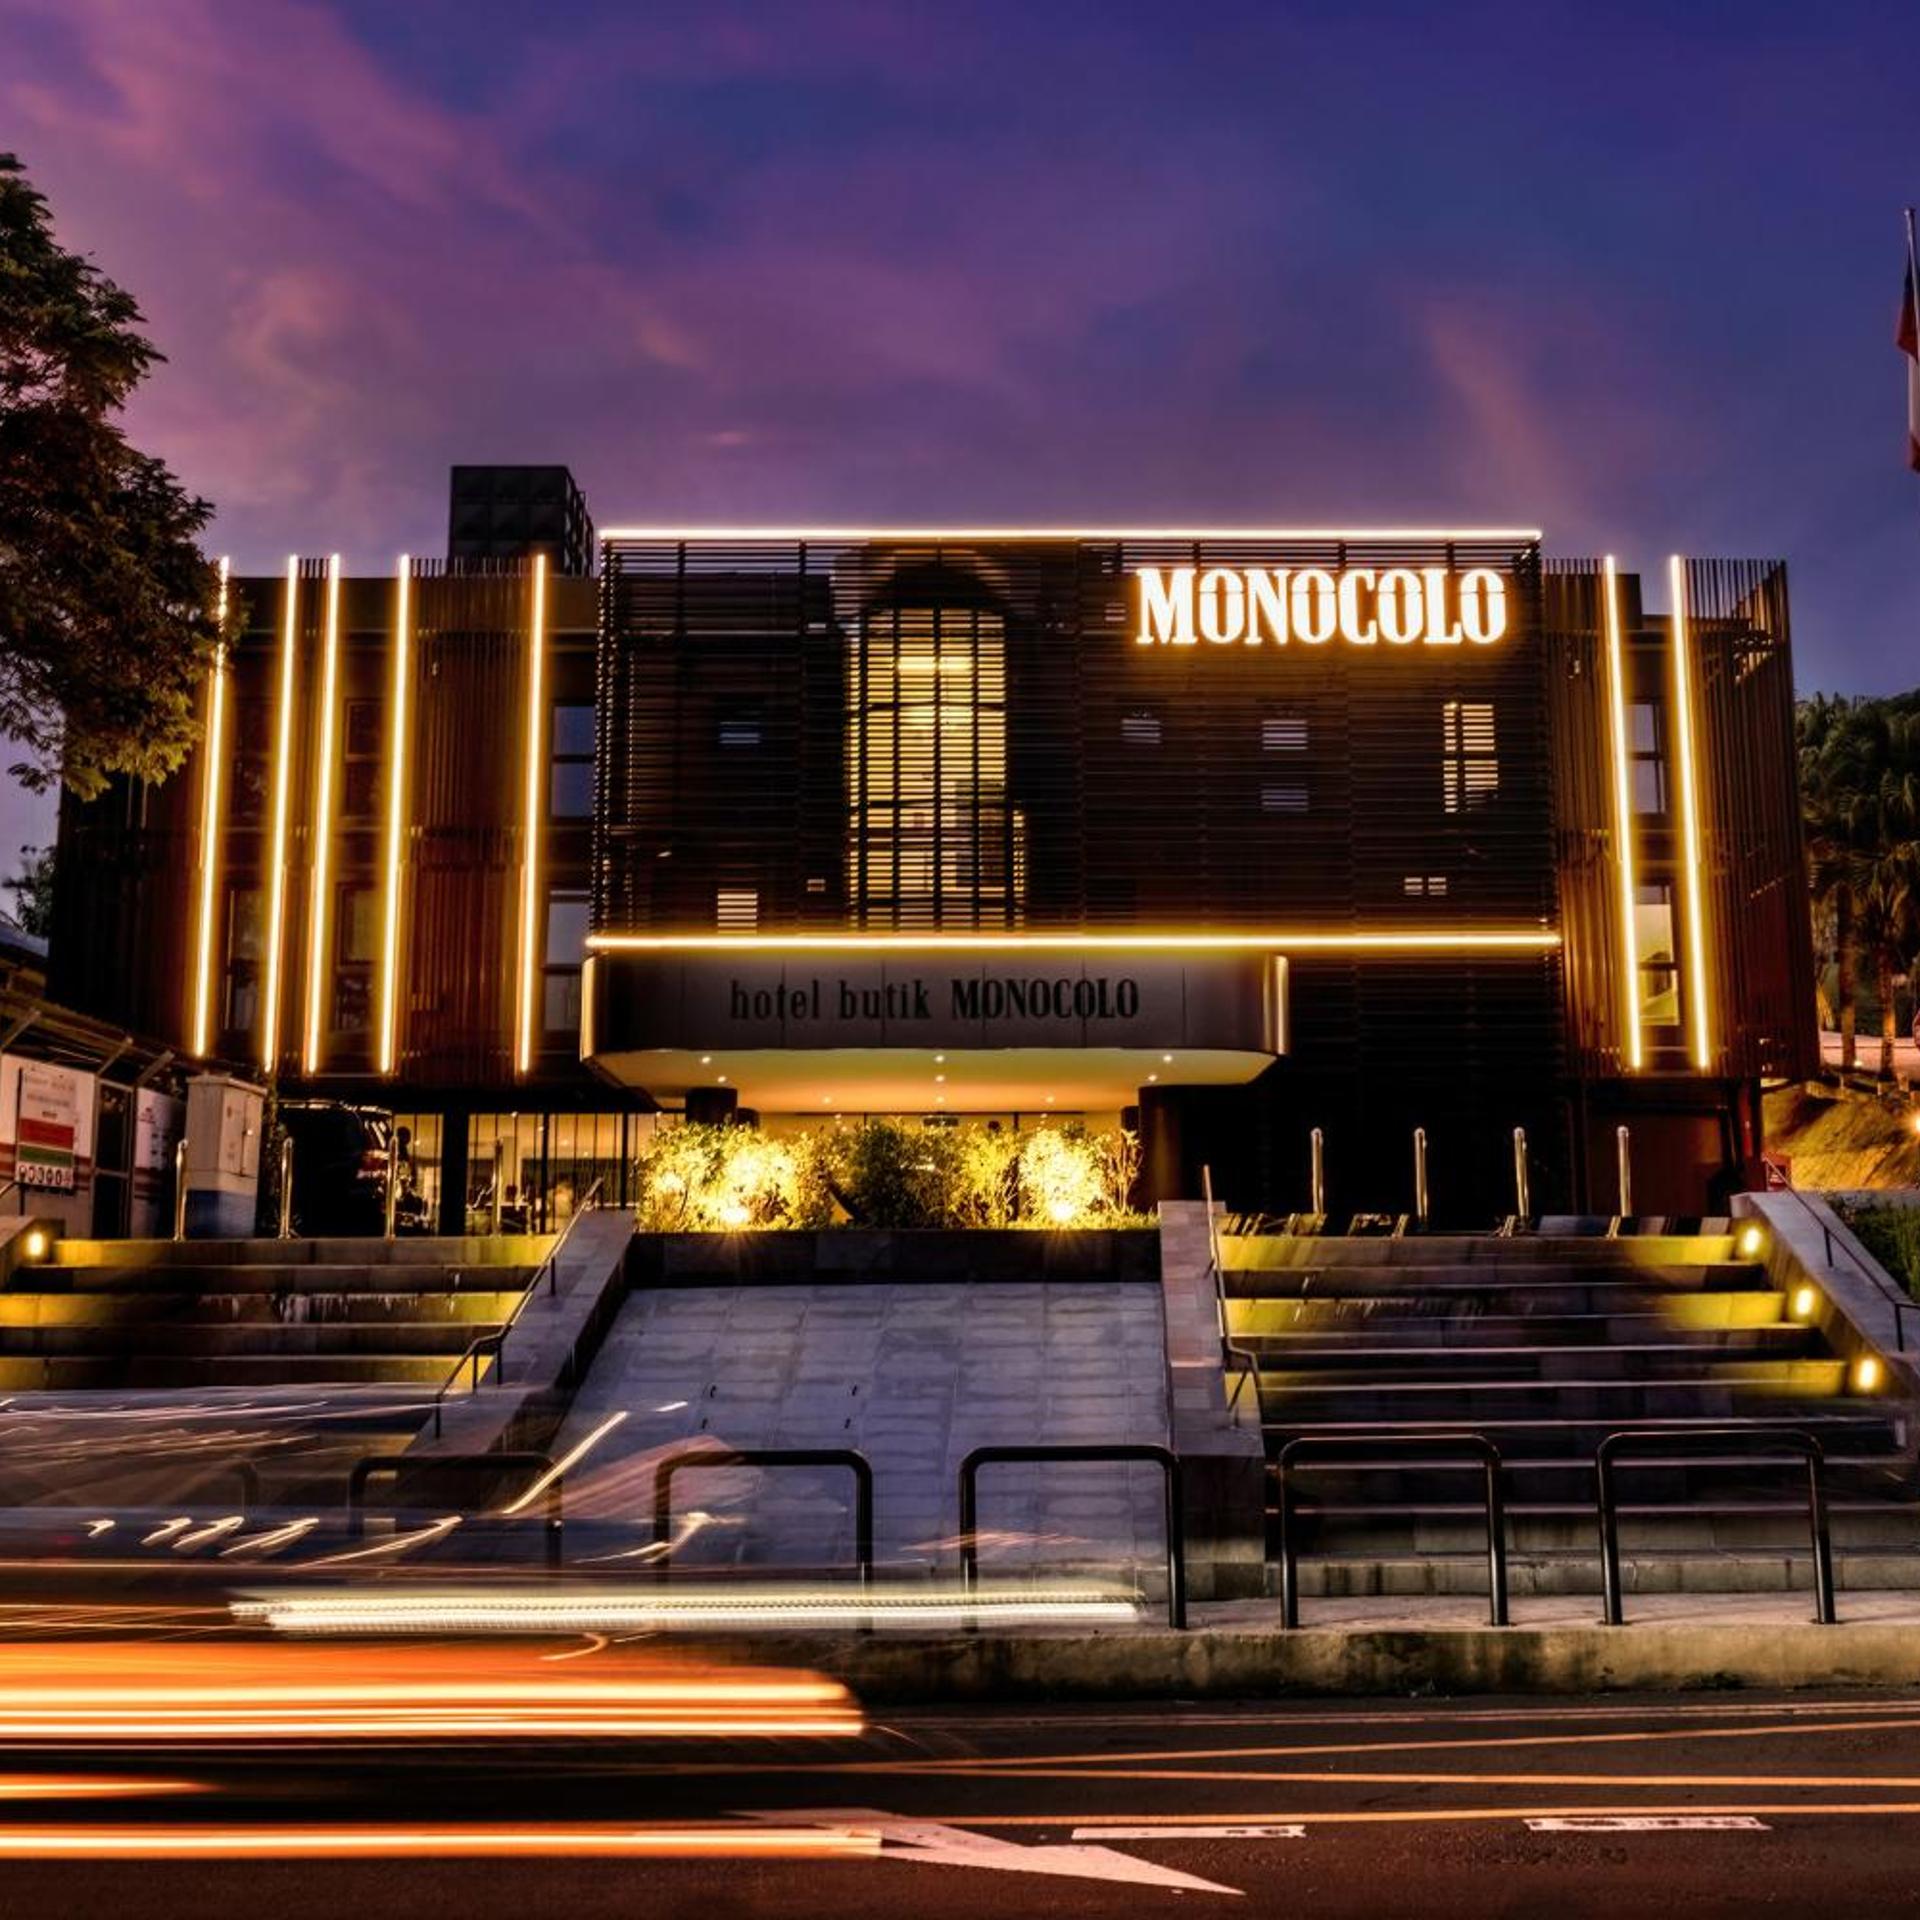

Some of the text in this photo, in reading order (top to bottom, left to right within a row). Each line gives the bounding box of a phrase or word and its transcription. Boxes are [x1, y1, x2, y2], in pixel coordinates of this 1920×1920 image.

[1136, 568, 1507, 645] MONOCOLO
[729, 978, 1140, 1020] hotel butik MONOCOLO
